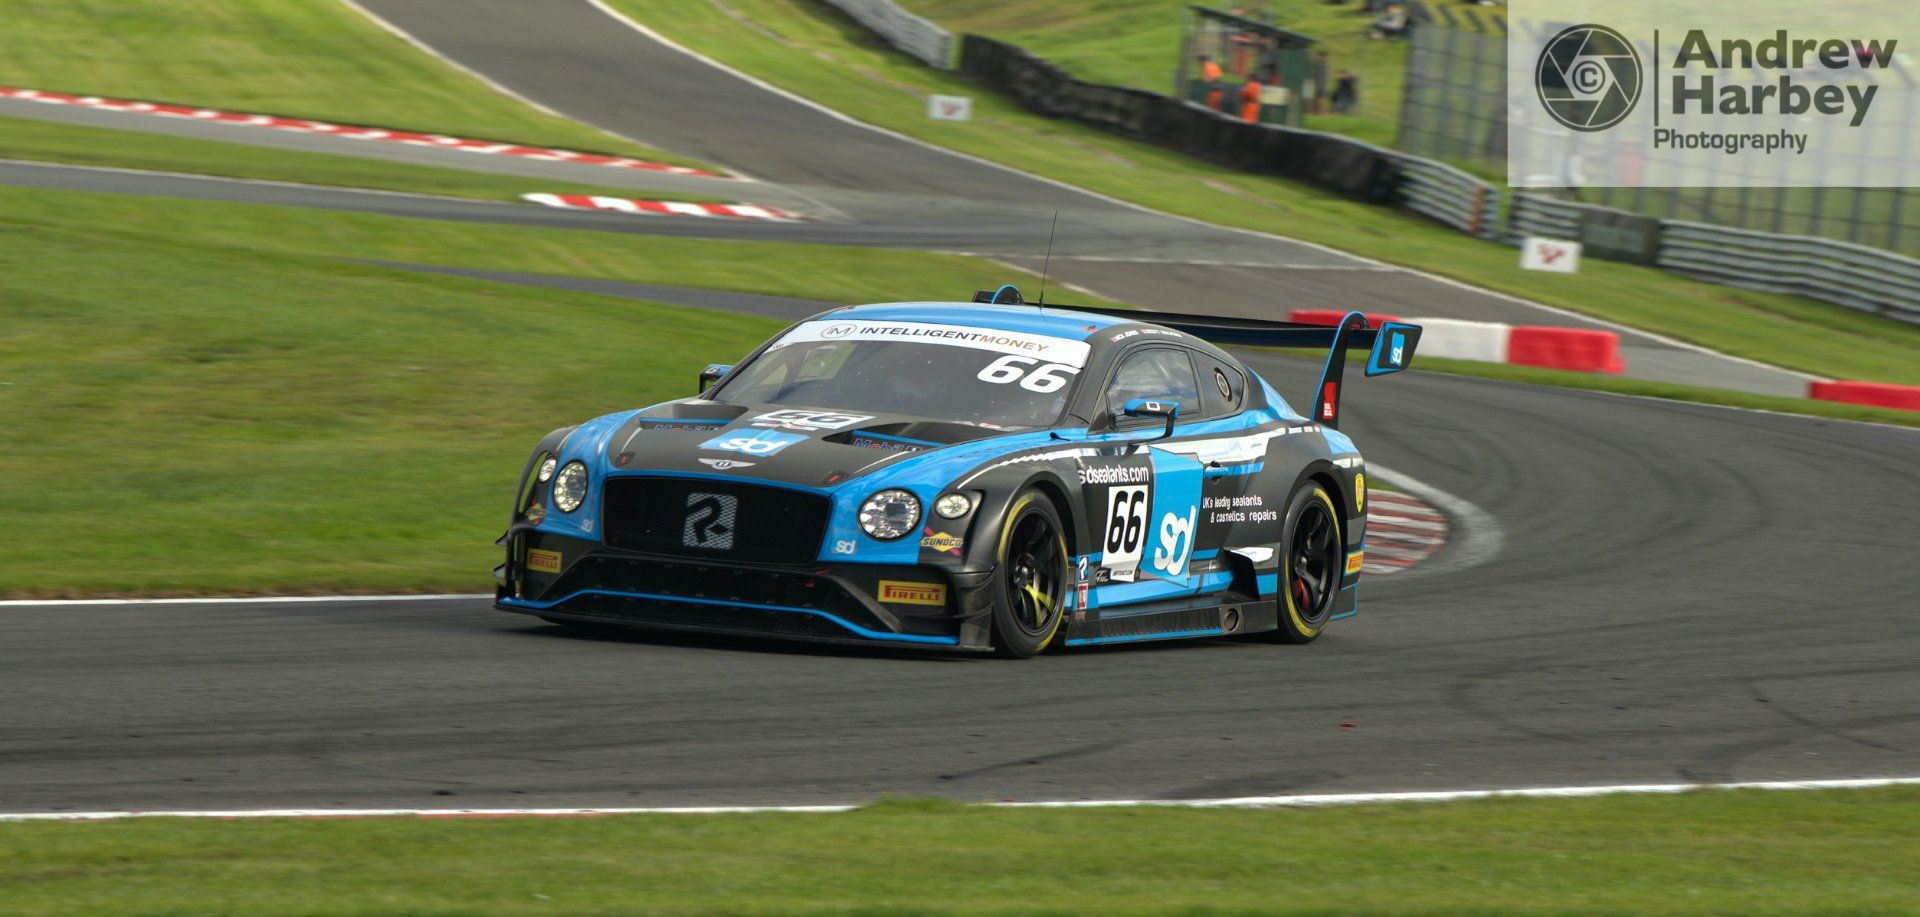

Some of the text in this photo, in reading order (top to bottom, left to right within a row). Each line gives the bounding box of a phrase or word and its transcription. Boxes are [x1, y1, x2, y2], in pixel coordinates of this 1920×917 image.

[977, 355, 1082, 394] 66
[1232, 494, 1263, 507] sealants
[1107, 490, 1146, 553] 66
[1248, 509, 1277, 524] repairs
[836, 540, 856, 554] sd
[922, 537, 962, 547] SUNOCO
[884, 585, 941, 601] PIRELLI
